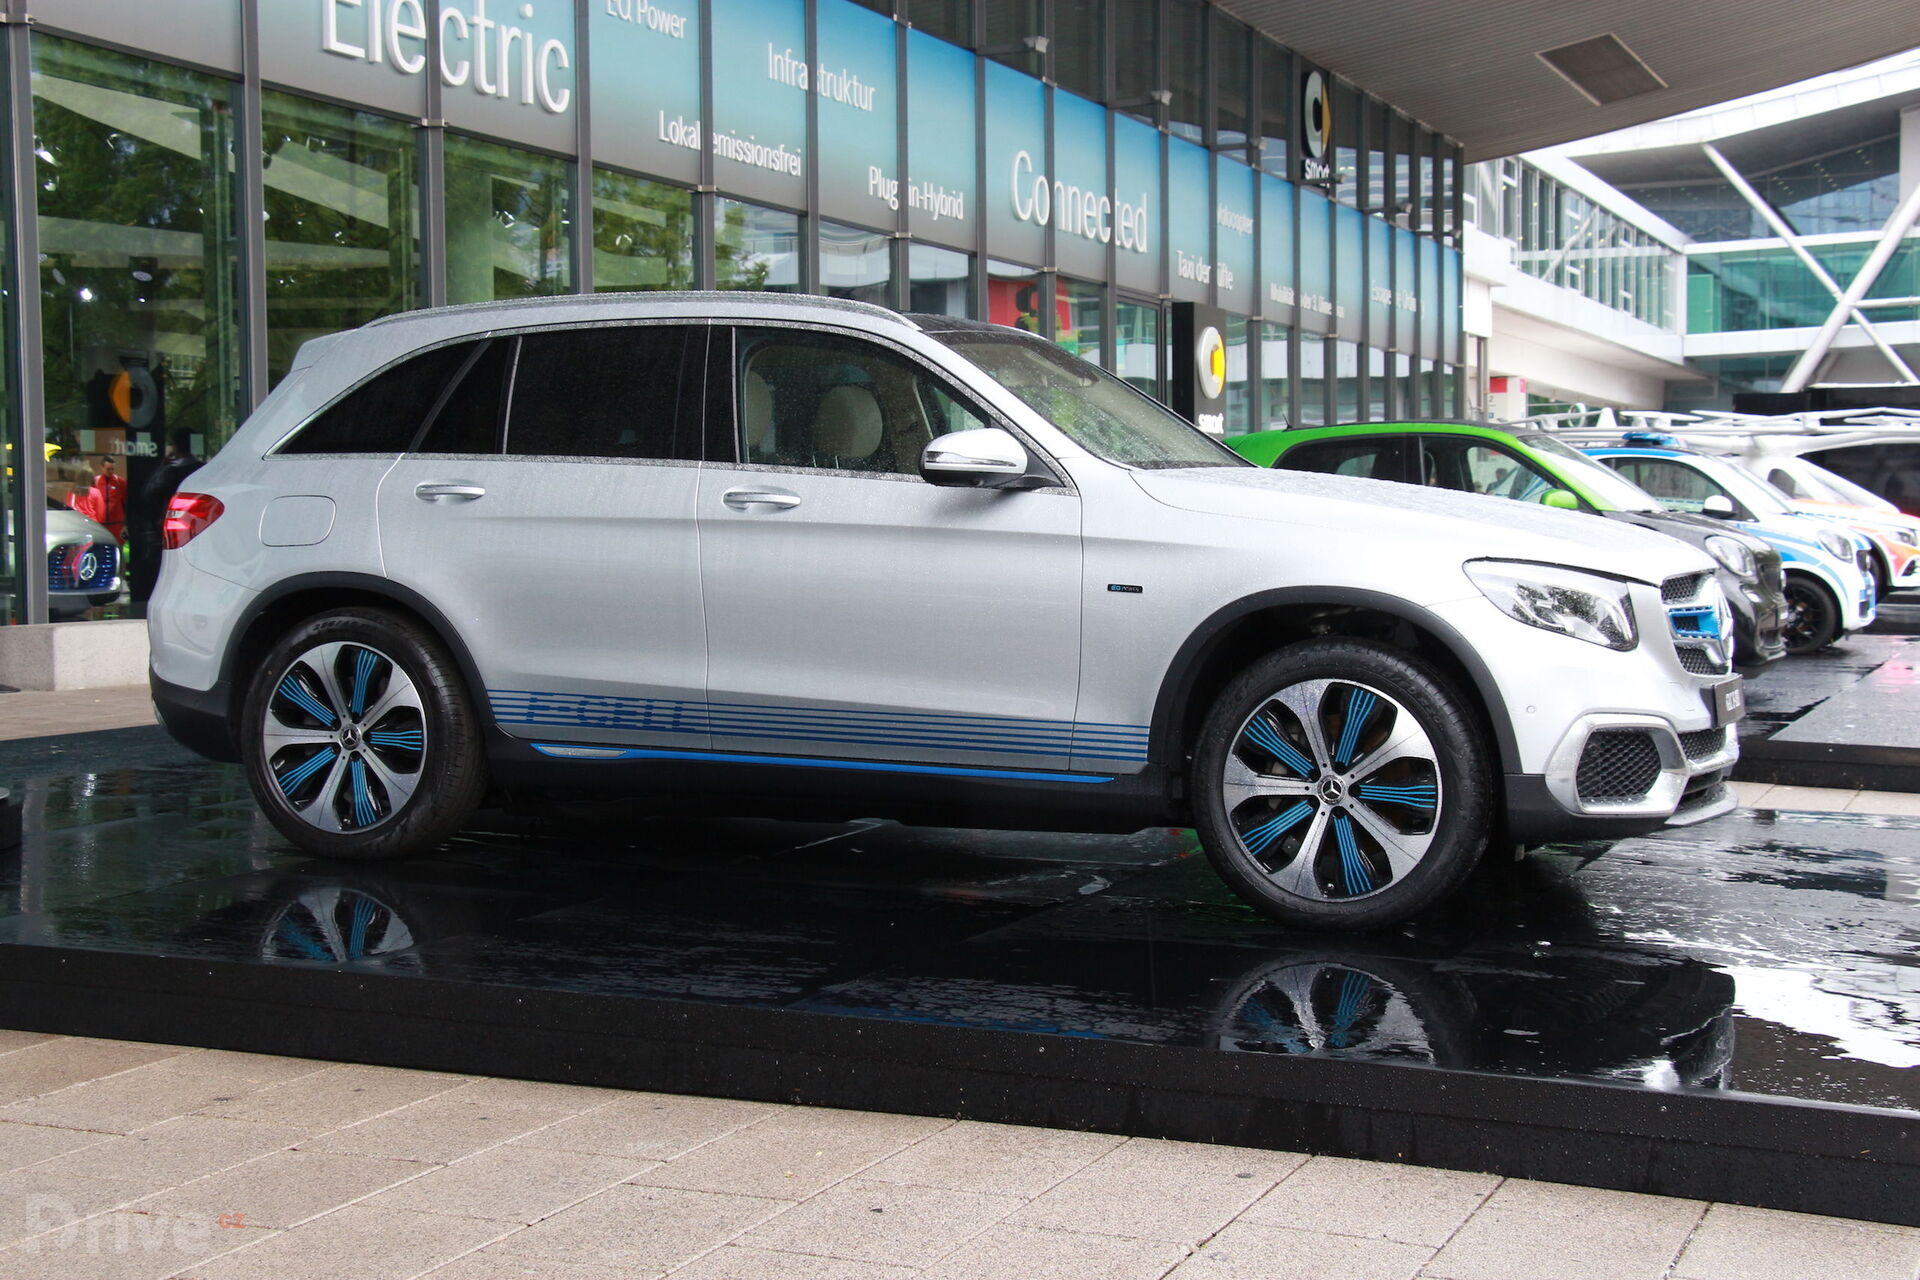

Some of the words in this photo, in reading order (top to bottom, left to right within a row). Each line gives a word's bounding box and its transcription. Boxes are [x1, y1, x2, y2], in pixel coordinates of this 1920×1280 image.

[637, 0, 687, 38] Power
[322, 0, 570, 114] Electric
[658, 109, 701, 150] Lokal
[1012, 150, 1148, 254] Connected
